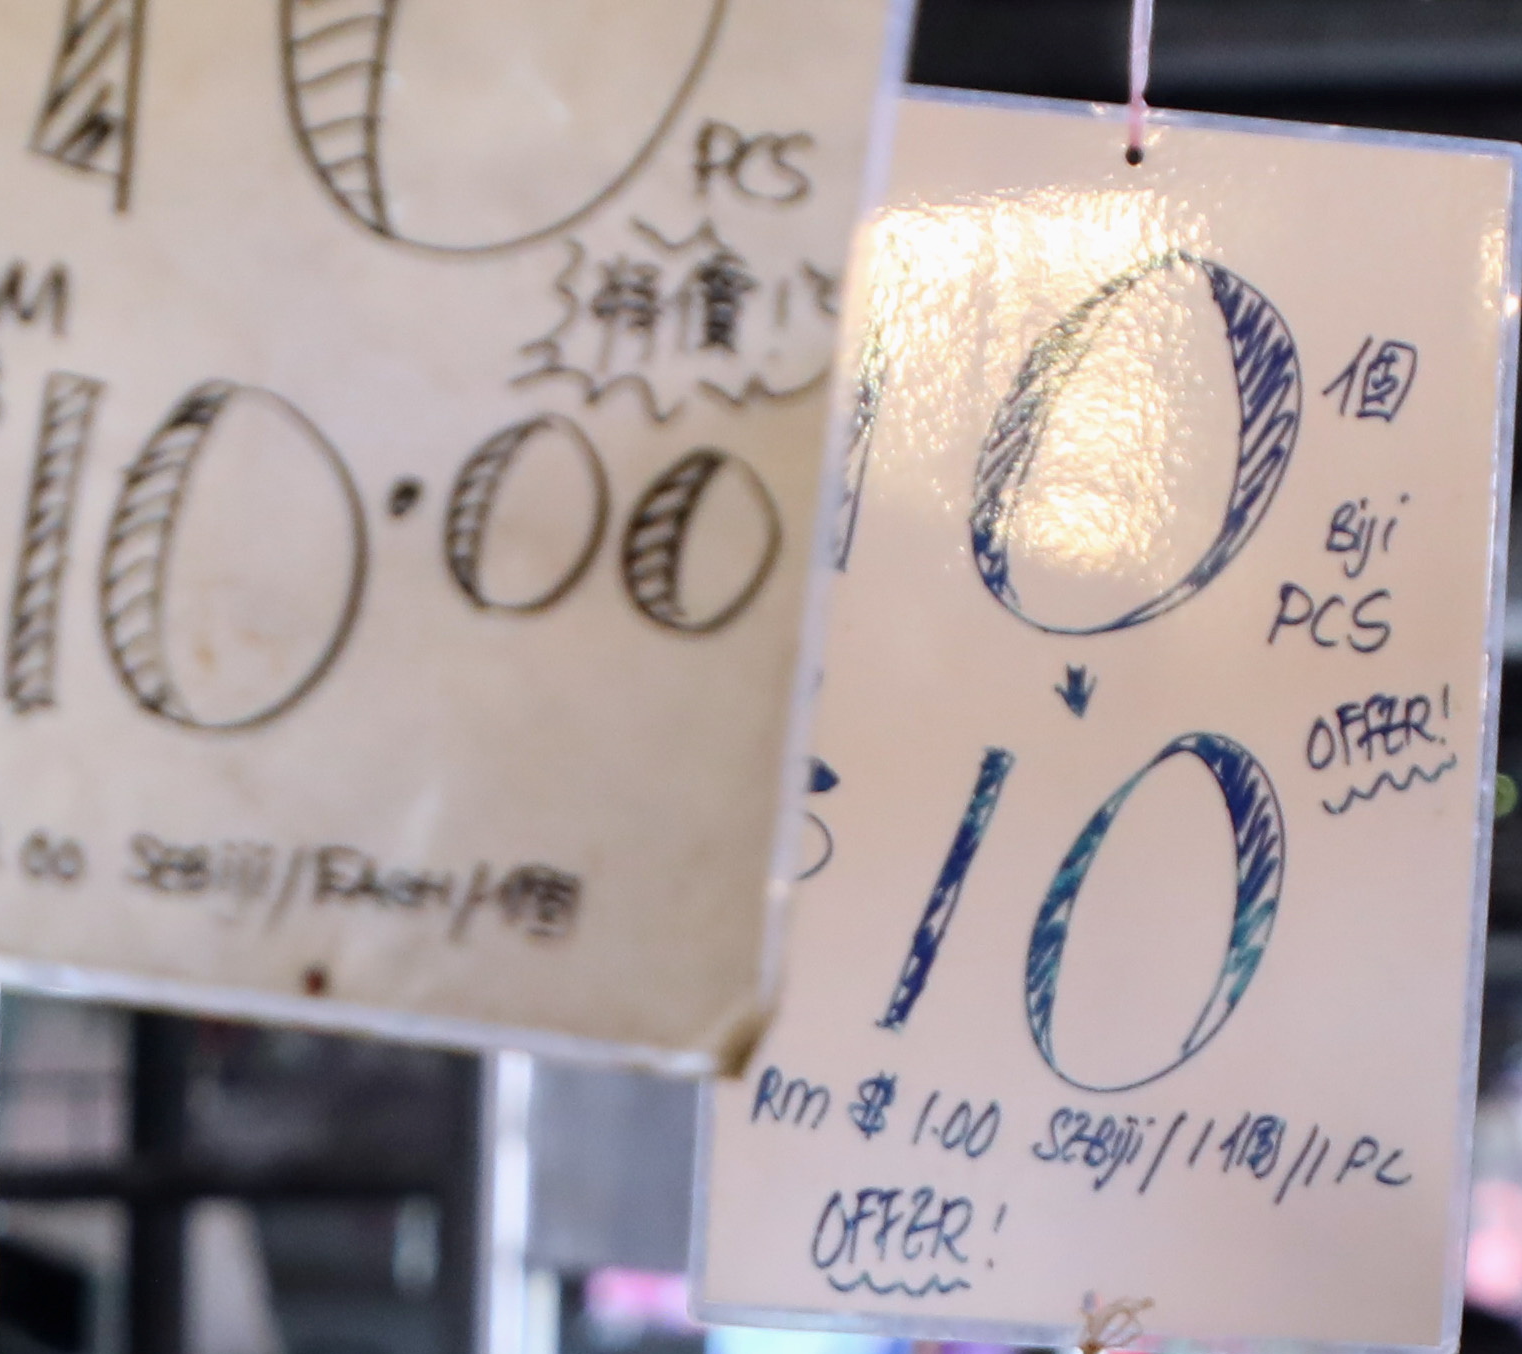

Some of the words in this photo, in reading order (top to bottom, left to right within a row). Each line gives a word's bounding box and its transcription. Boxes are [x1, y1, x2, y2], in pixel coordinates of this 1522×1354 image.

[696, 118, 816, 206] PCS
[1267, 582, 1392, 653] PCS
[876, 732, 1287, 1091] 10
[810, 1186, 1007, 1269] OFFER!
